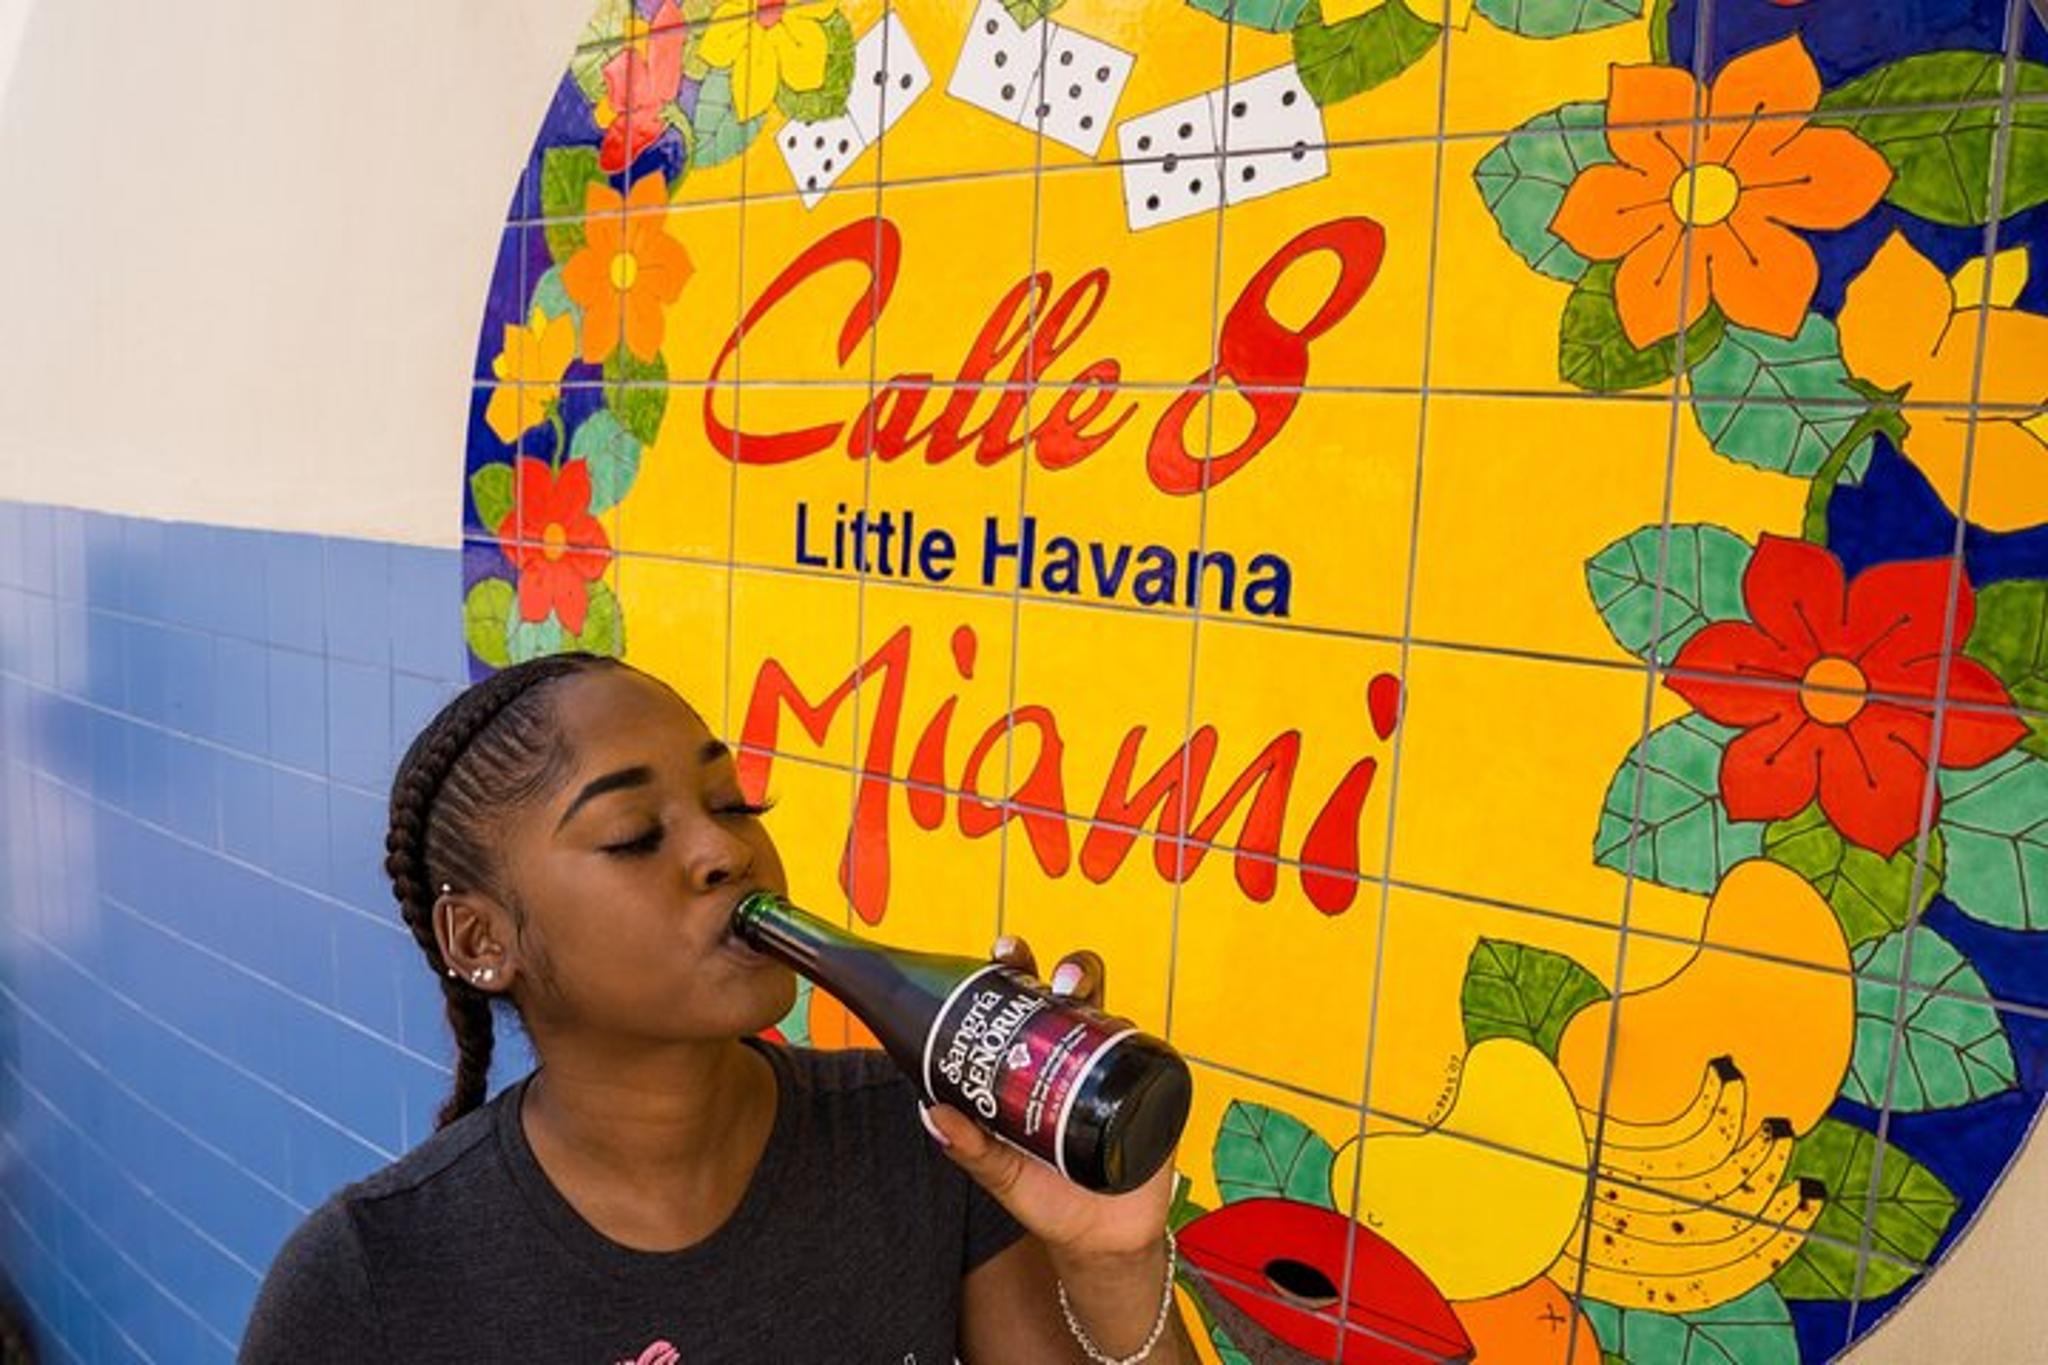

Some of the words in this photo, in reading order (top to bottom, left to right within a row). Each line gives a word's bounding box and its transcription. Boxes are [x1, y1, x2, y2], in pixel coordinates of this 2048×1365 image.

[703, 216, 1139, 471] Calle
[1146, 216, 1386, 497] 8
[795, 502, 957, 582] Little
[982, 516, 1293, 618] Havana
[736, 624, 1405, 926] Miami
